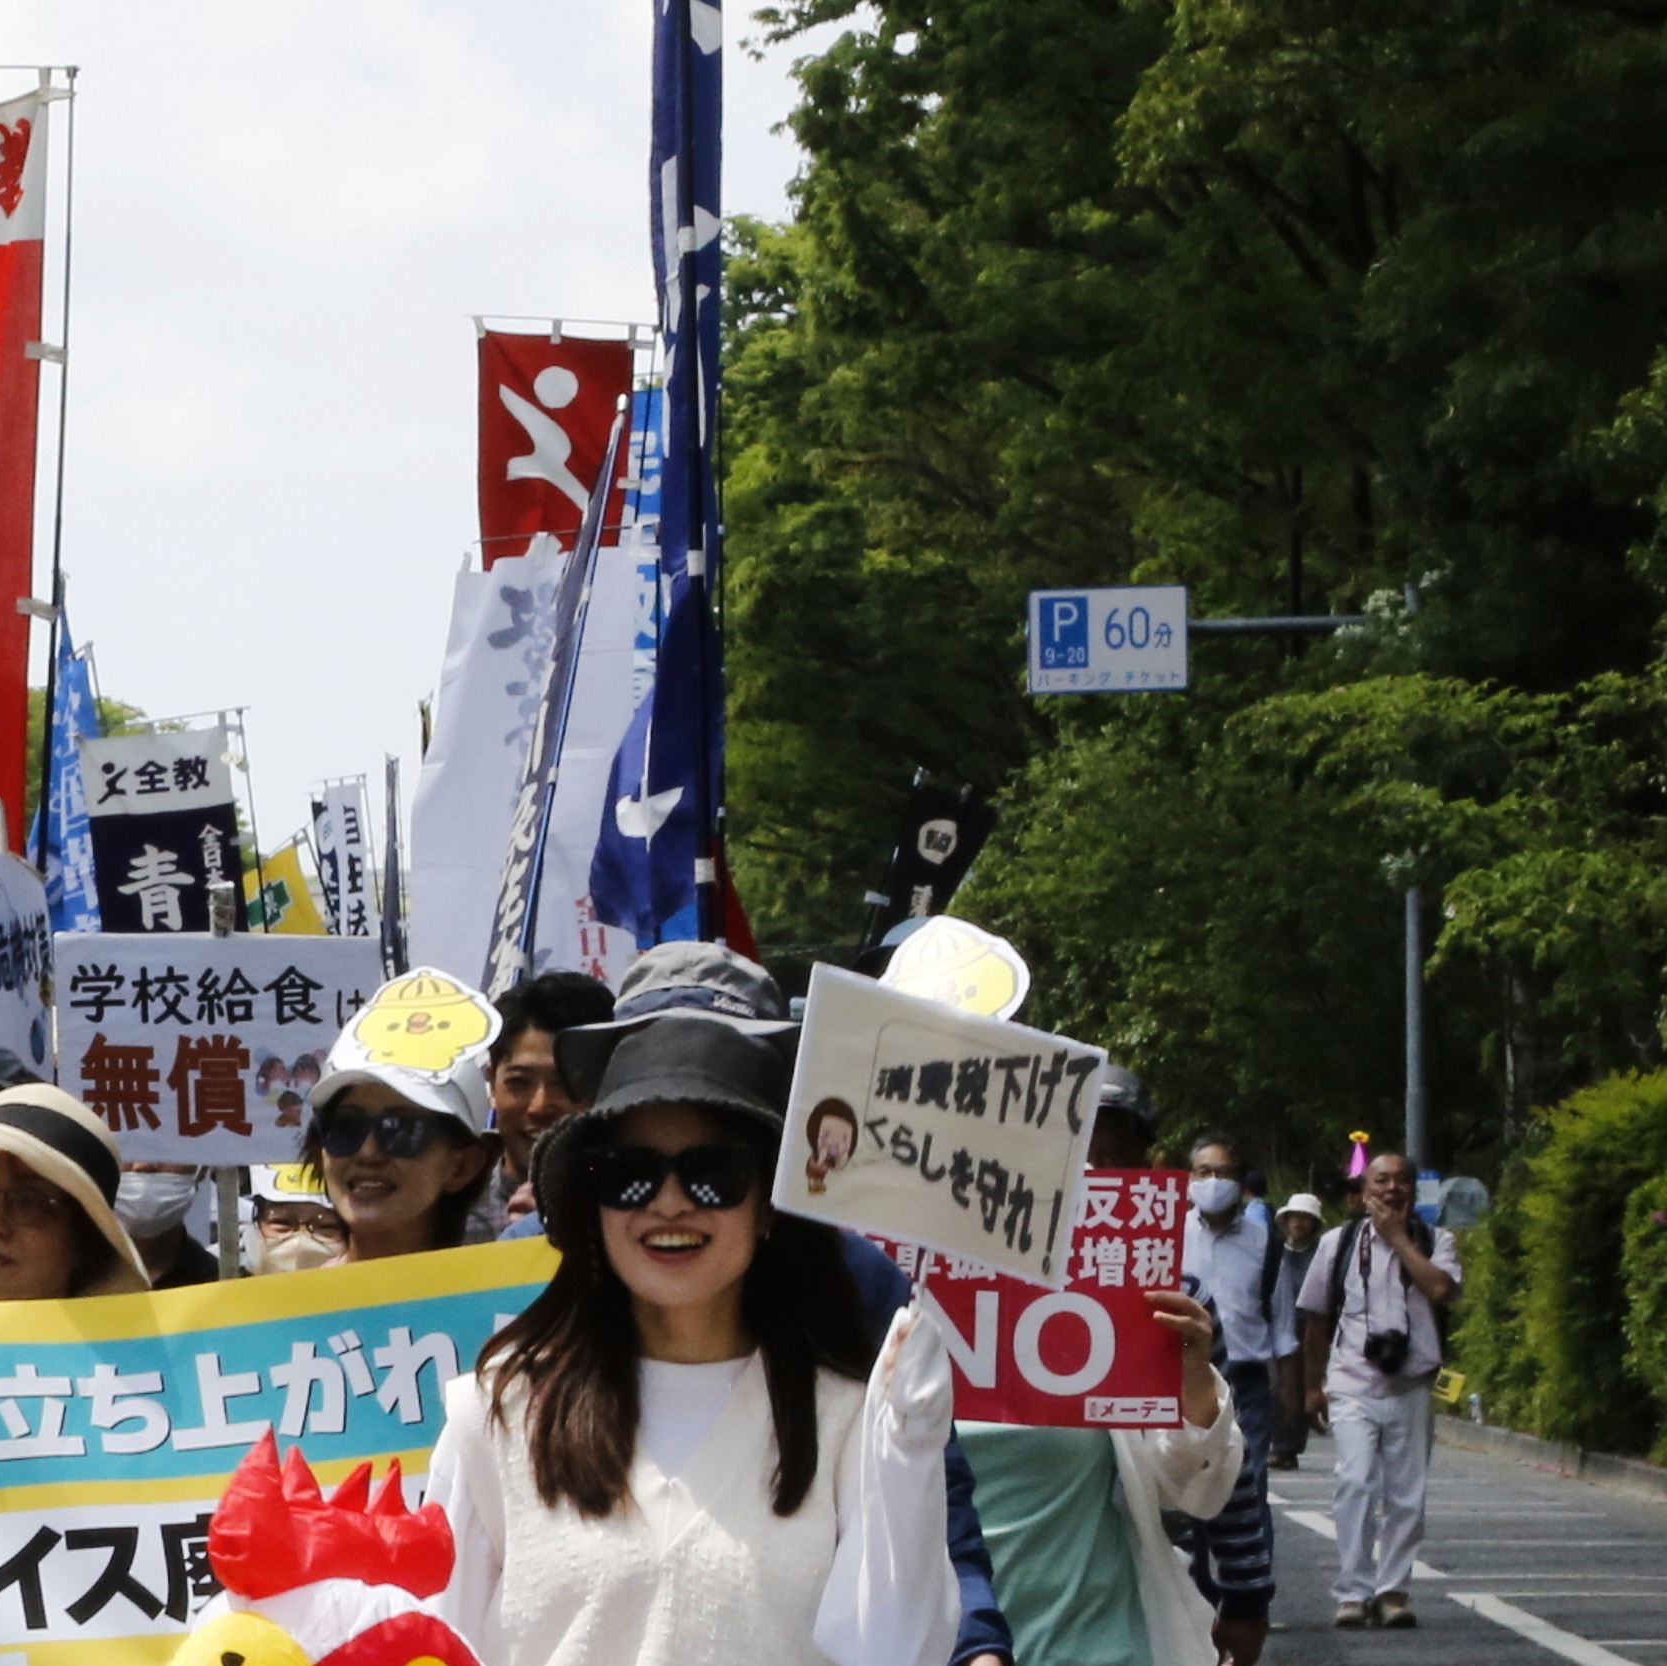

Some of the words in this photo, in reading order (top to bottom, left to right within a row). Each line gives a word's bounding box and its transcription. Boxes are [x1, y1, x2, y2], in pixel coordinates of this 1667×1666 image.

[1053, 601, 1079, 643] P
[1104, 606, 1173, 650] 60分
[1044, 647, 1085, 665] 9-20
[133, 755, 211, 797] 全教
[116, 842, 196, 932] 青
[69, 963, 365, 1030] 学校給食は
[80, 1032, 253, 1137] 無償
[875, 1048, 1101, 1136] 消費税下げて
[1077, 1176, 1180, 1230] 反対
[924, 1290, 1116, 1396] NO
[1100, 1401, 1175, 1418] メーデー
